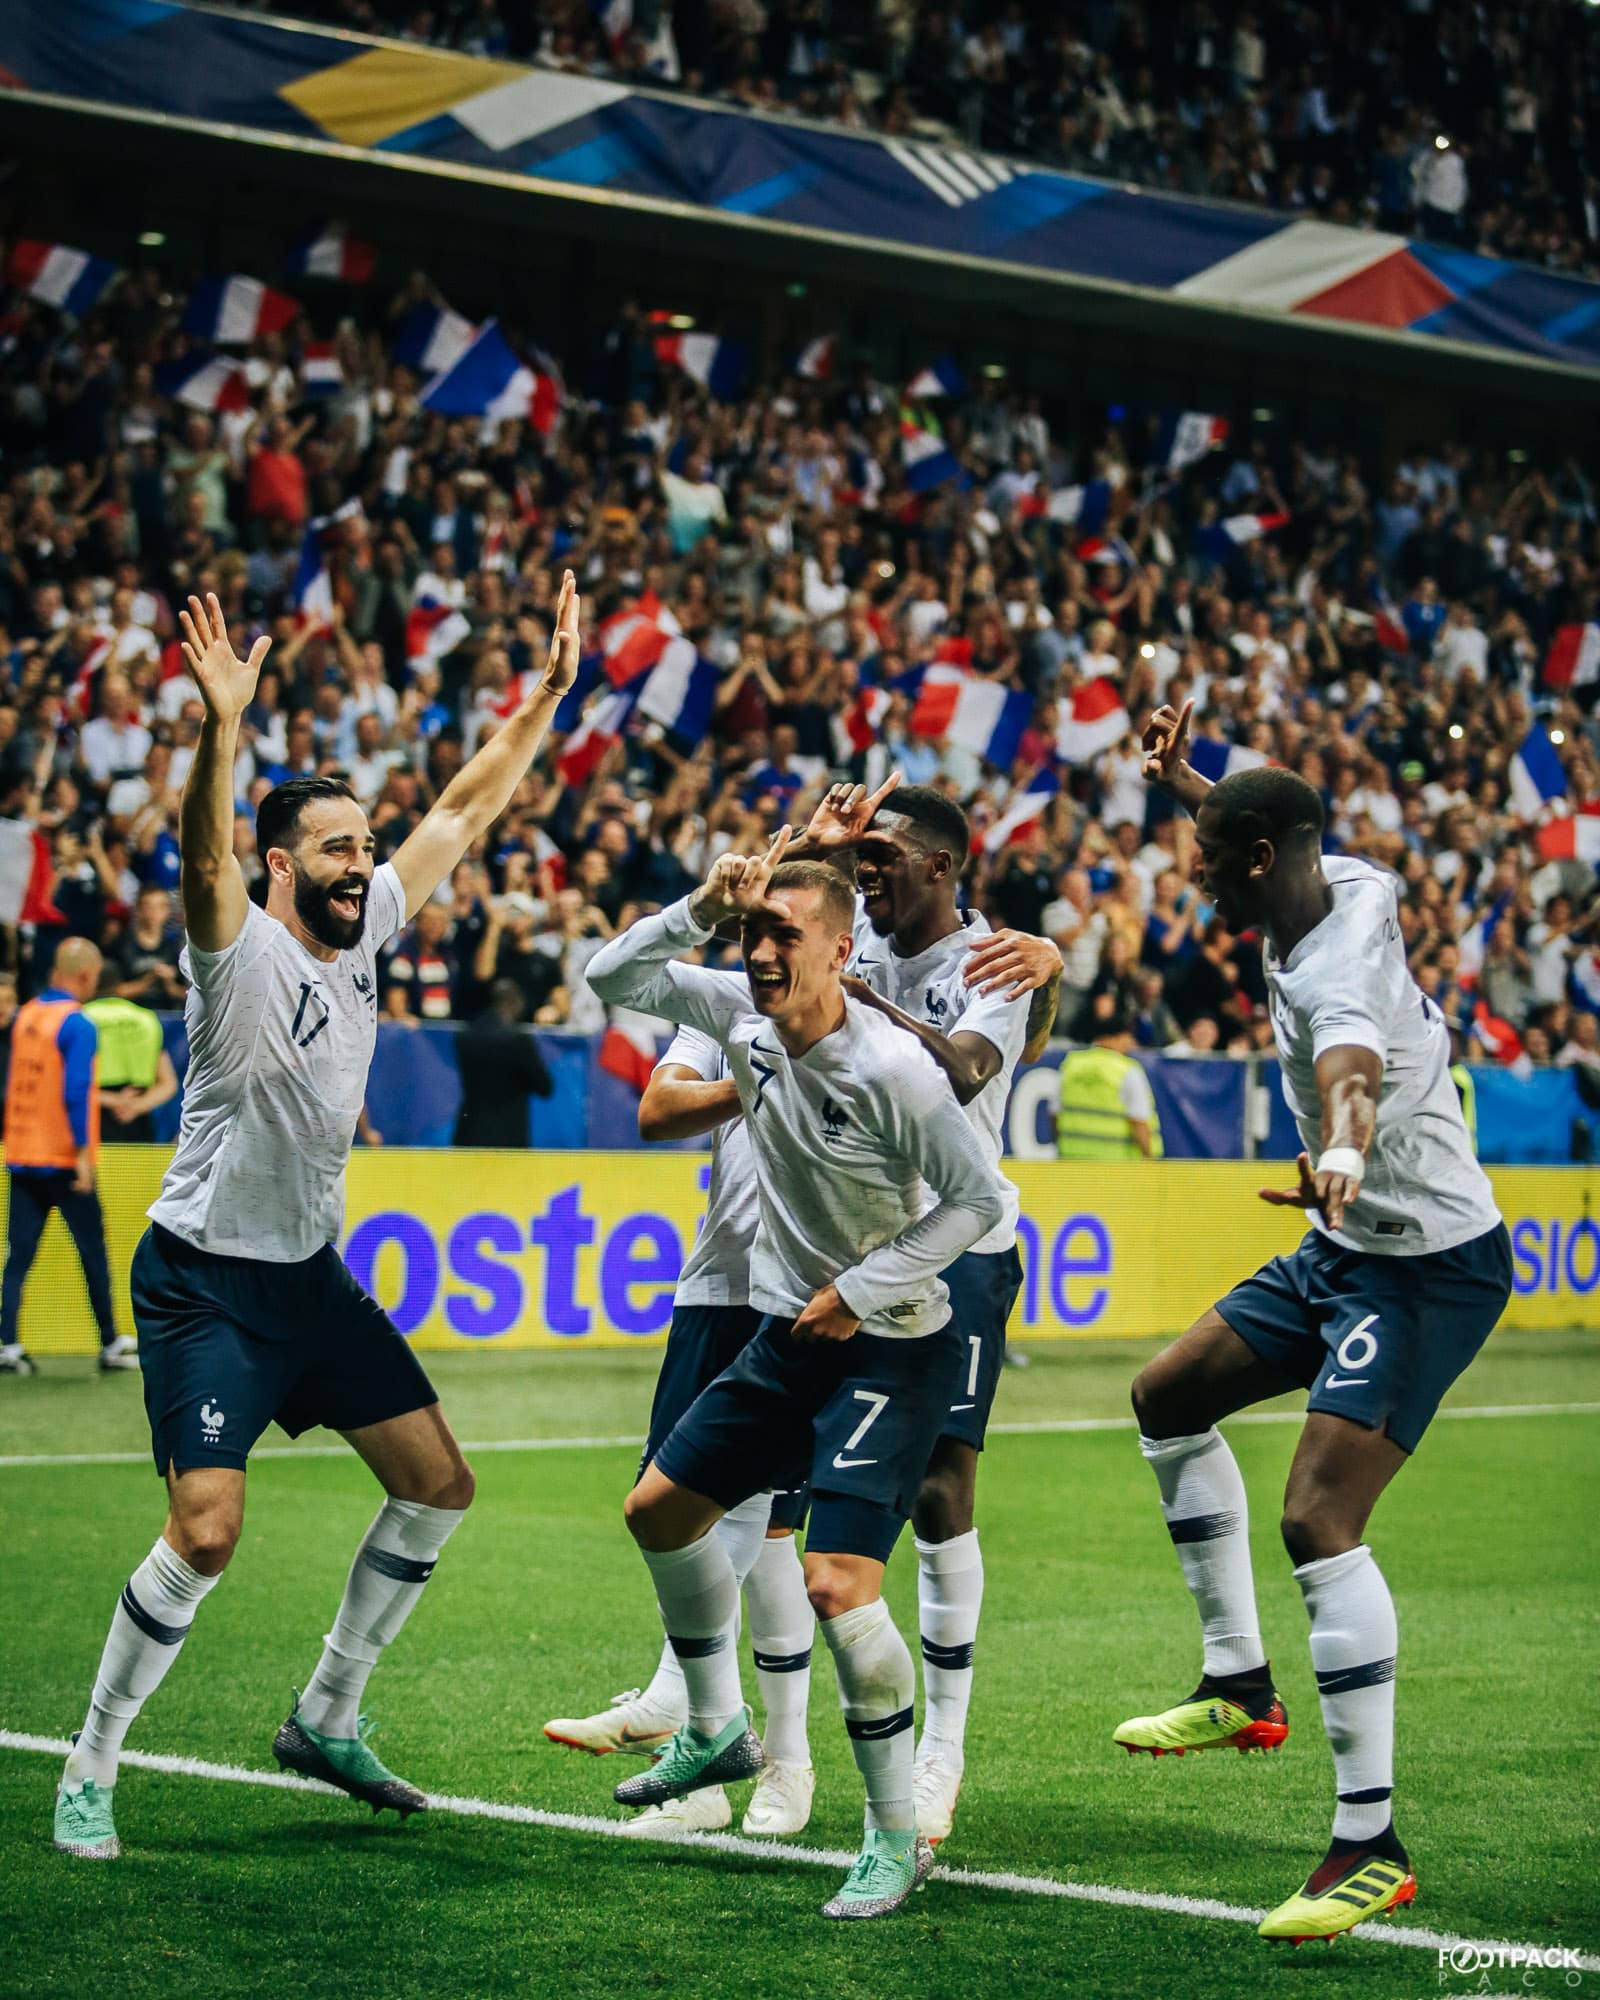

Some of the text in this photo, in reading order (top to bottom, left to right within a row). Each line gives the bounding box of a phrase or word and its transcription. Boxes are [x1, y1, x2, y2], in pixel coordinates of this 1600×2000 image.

[750, 1058, 776, 1113] 7
[344, 1165, 1112, 1337] oste ne
[1511, 1217, 1600, 1294] SIO
[1337, 1314, 1380, 1370] 6
[844, 1390, 890, 1450] 7
